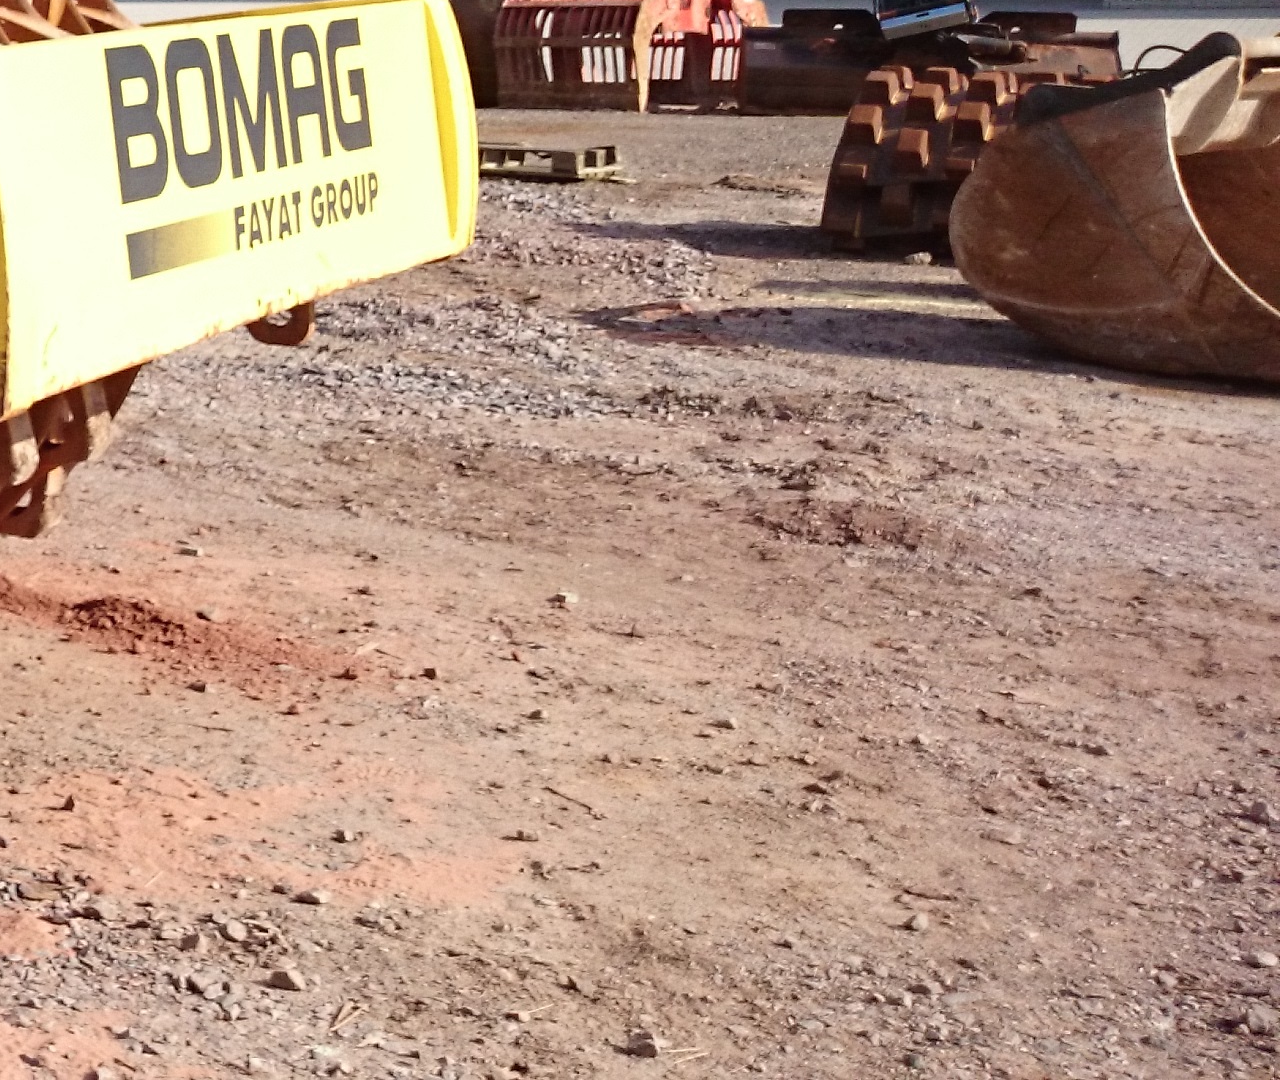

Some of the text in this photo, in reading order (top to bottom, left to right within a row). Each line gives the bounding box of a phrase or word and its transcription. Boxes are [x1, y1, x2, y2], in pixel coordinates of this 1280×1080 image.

[104, 18, 372, 204] BOMAG
[234, 172, 378, 251] FAYAT GROUP
